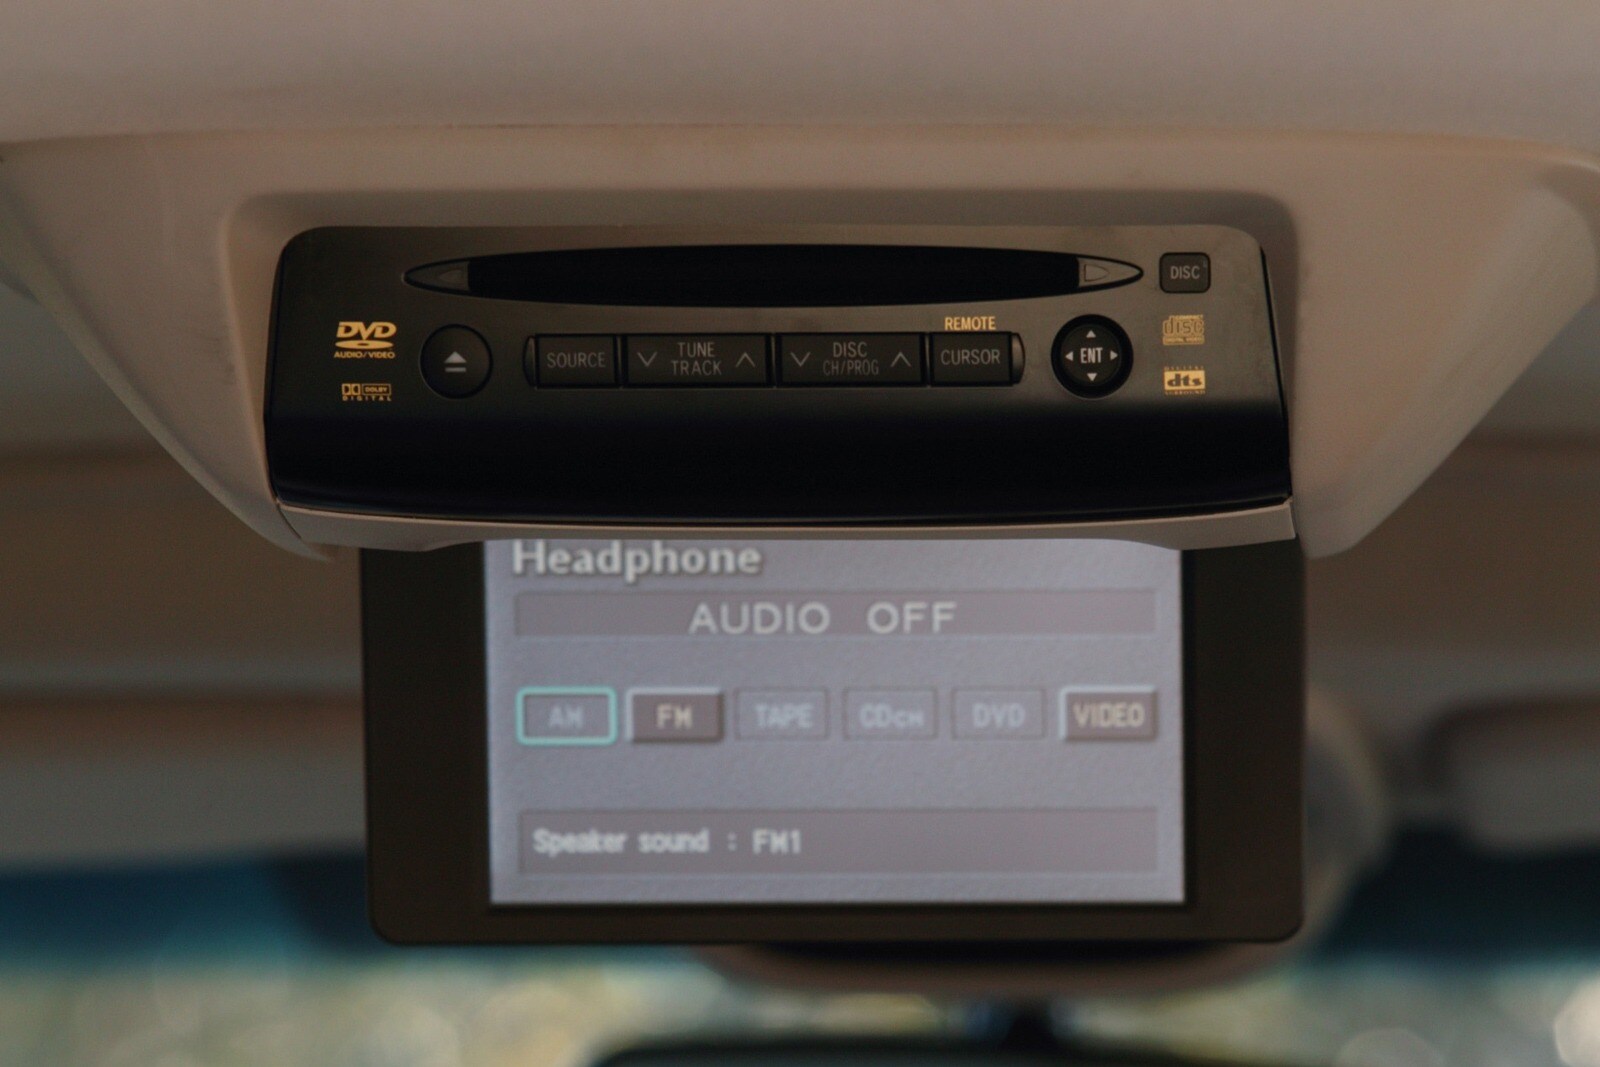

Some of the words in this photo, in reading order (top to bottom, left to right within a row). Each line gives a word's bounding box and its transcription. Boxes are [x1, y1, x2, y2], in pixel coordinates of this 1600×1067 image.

[1170, 265, 1200, 279] DISC
[336, 321, 397, 340] DVD
[944, 316, 997, 331] REMOTE
[333, 351, 396, 360] AUDIO/VIDEO
[677, 341, 715, 358] TUNE
[832, 341, 868, 357] DISC
[940, 349, 1001, 366] CURSOR
[1080, 347, 1104, 364] ENT
[546, 352, 606, 369] SOURCE
[671, 360, 722, 376] TRACK
[822, 360, 879, 377] CH/PROG
[1167, 373, 1203, 387] dts
[512, 540, 763, 583] Headphone
[688, 601, 831, 635] AUDIO
[866, 601, 957, 635] OFF
[547, 703, 584, 729] AM
[656, 703, 694, 730] FM
[754, 703, 814, 730] TAPE
[972, 702, 1026, 729] DVD
[1072, 702, 1146, 729] VIDEO
[532, 826, 628, 858] Speaker
[637, 826, 710, 854] sound
[751, 828, 802, 855] FM1
